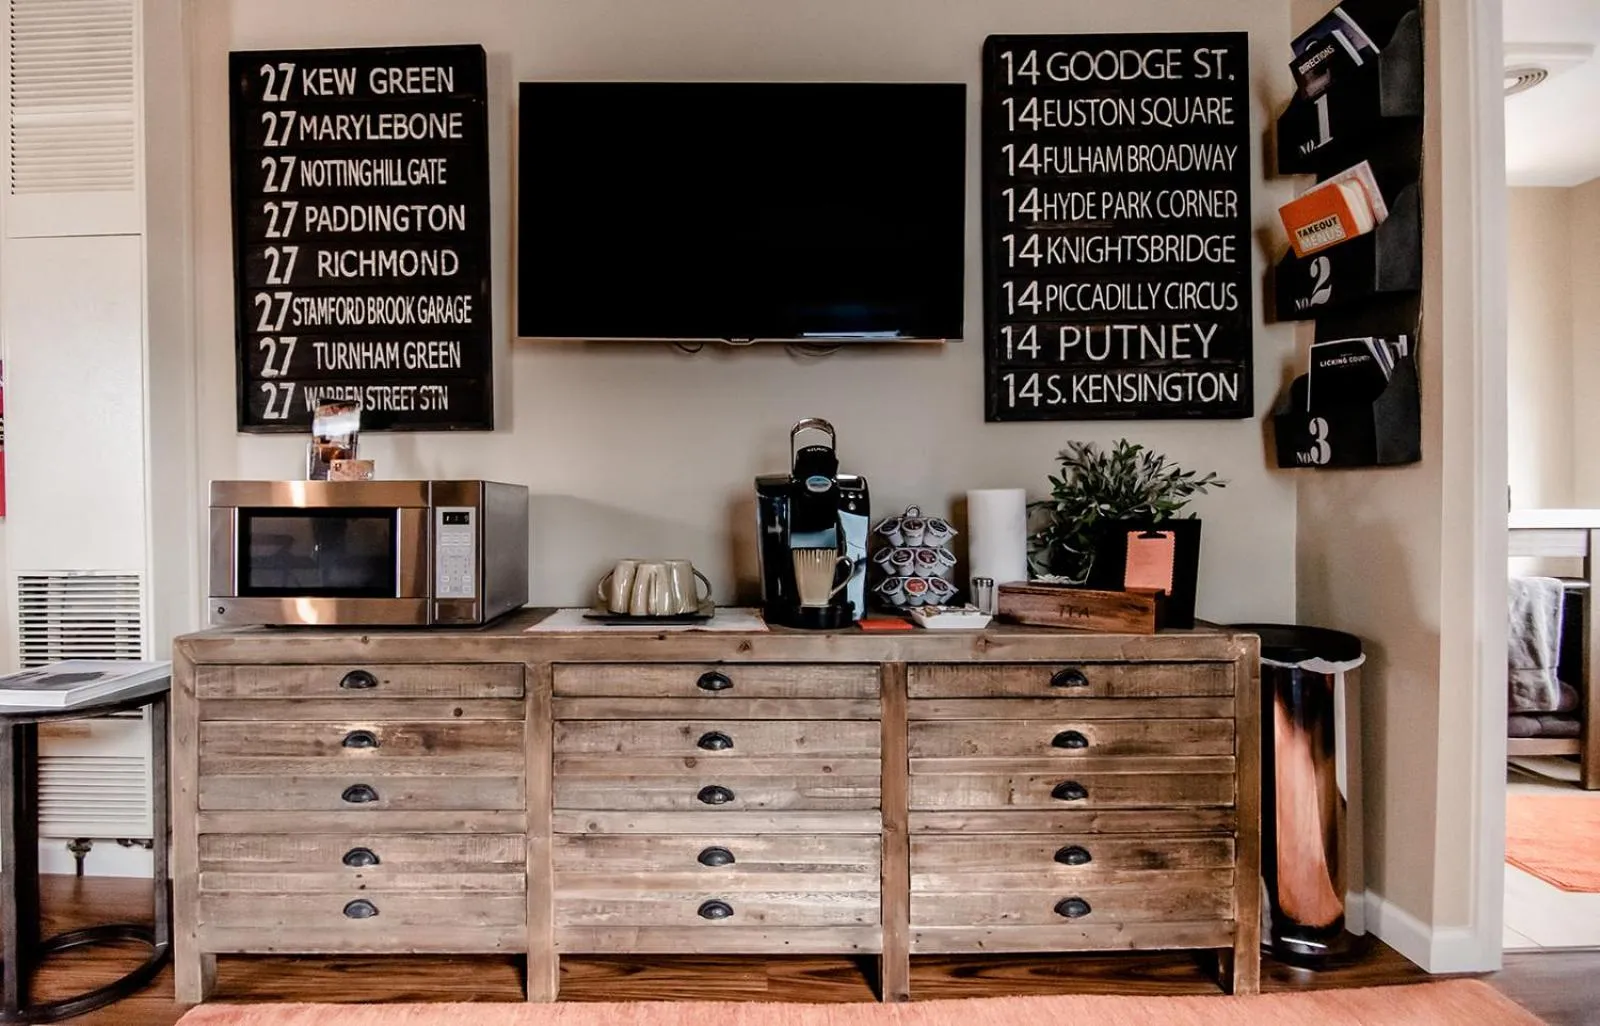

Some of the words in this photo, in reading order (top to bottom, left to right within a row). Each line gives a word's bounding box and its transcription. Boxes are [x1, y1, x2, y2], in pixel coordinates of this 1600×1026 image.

[1001, 50, 1040, 85] 14
[1047, 49, 1182, 81] GOODGE
[1194, 48, 1235, 81] ST.
[1298, 44, 1335, 75] DIRECTIONS
[261, 63, 295, 101] 27
[303, 68, 356, 95] KEW
[370, 67, 454, 95] GREEN
[262, 111, 296, 146] 27
[300, 113, 463, 141] MARYLEBONE
[1002, 97, 1041, 131] 14
[1044, 98, 1135, 127] EUSTON
[1140, 97, 1234, 128] SQUARE
[262, 156, 296, 192] 27
[1002, 144, 1042, 176] 14
[1043, 146, 1123, 174] FULHAM
[1128, 144, 1238, 173] BROADWAY
[264, 201, 298, 238] 27
[305, 204, 466, 232] PADDINGTON
[1002, 187, 1042, 222] 14
[1044, 192, 1096, 220] HYDE
[1102, 191, 1153, 219] PARK
[1157, 190, 1238, 218] CORNER
[1297, 216, 1338, 238] TAKEOUT
[1303, 225, 1343, 249] MENUS
[264, 246, 298, 284] 27
[317, 249, 459, 278] RICHMOND
[1002, 234, 1043, 267] 14
[1047, 235, 1236, 265] KNIGHTSBRIDGE
[255, 292, 292, 332] 27
[292, 297, 365, 326] STAMFORD
[368, 297, 415, 324] BROOK
[417, 295, 472, 324] GARAGE
[1002, 281, 1042, 315] 14
[1046, 283, 1162, 312] PICCADILLY
[1165, 282, 1238, 311] CIRCUS
[259, 337, 297, 377] 27
[313, 342, 400, 369] TURNHAM
[404, 341, 461, 369] GREEN
[1001, 325, 1041, 360] 14
[1059, 323, 1218, 361] PUTNEY
[1319, 357, 1348, 368] LICKING
[261, 382, 295, 420] 27
[366, 386, 417, 411] STREET
[419, 385, 449, 411] STN
[1003, 373, 1042, 408] 14
[1047, 374, 1067, 405] S.
[1072, 372, 1238, 404] KENSINGTON
